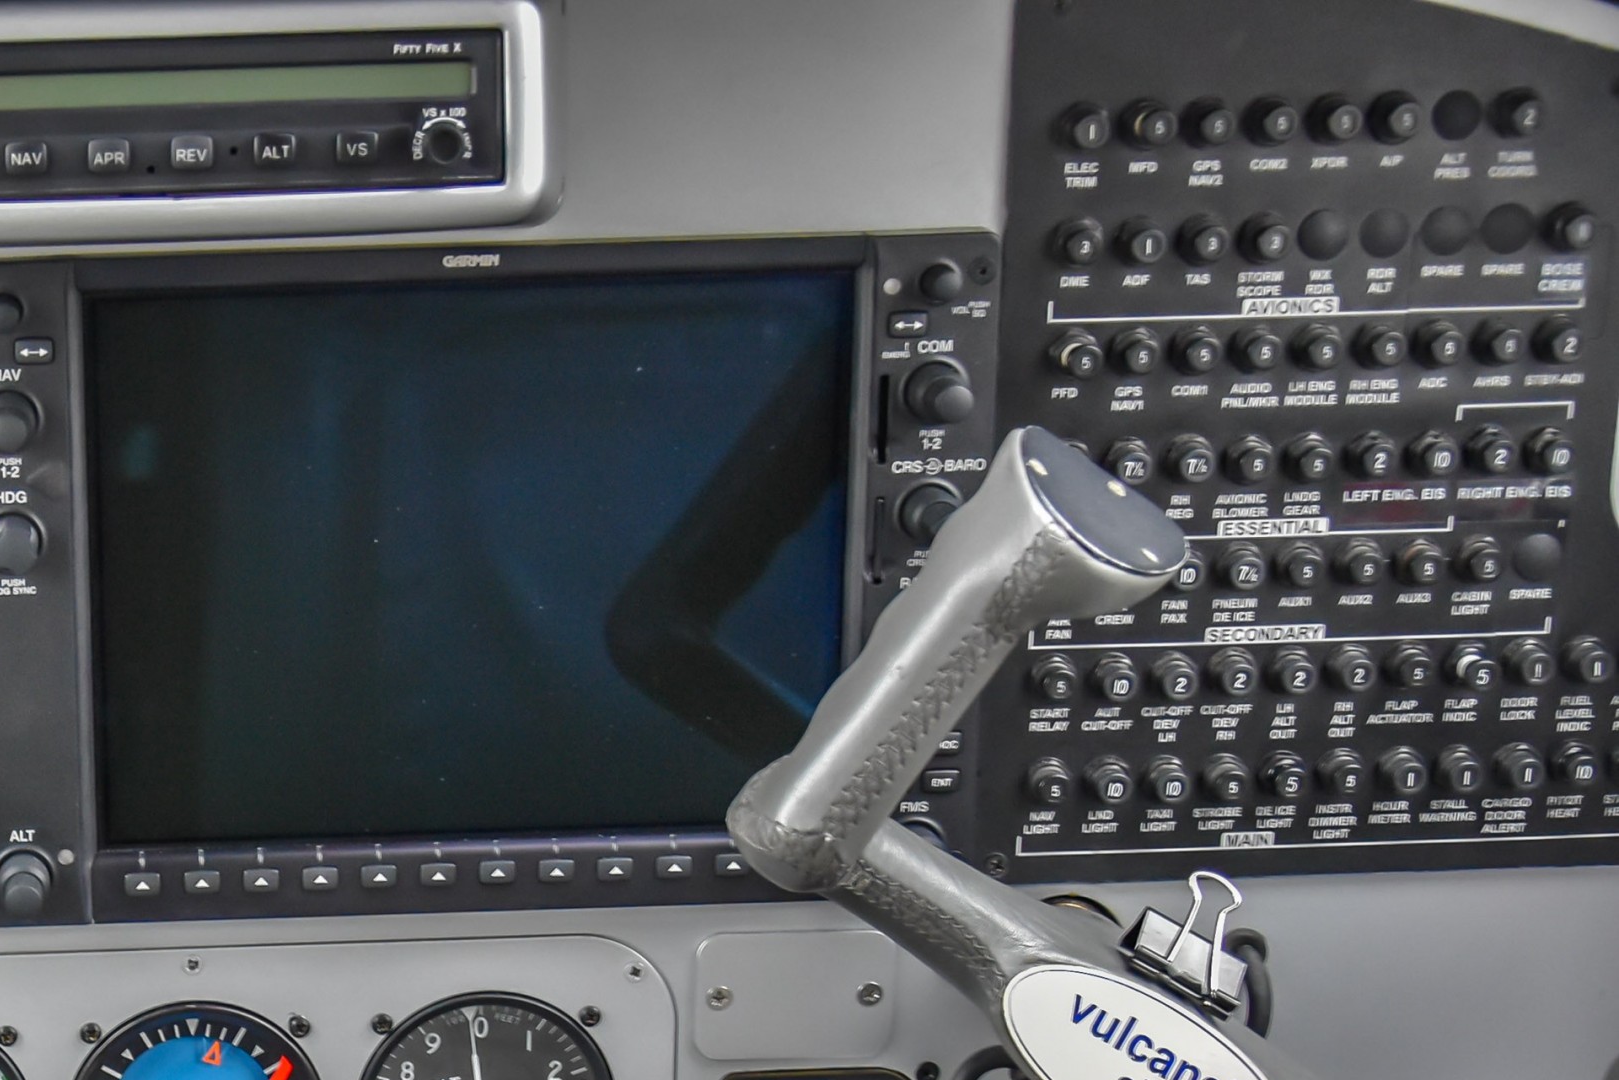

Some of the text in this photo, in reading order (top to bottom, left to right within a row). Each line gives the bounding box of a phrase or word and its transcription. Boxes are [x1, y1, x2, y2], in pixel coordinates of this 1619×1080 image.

[453, 43, 461, 53] X
[175, 146, 208, 163] REV
[261, 143, 291, 160] ALT
[346, 141, 368, 158] VS
[10, 151, 43, 167] NAV
[93, 151, 126, 167] APR
[443, 254, 500, 267] GARMIN
[1245, 299, 1334, 314] AVIONICS
[918, 340, 954, 352] COM
[922, 438, 942, 449] 1-2
[892, 458, 986, 473] CRS BARO
[0, 467, 20, 478] 1-2
[1343, 490, 1381, 503] LEFT
[1421, 488, 1446, 501] EIS
[1457, 487, 1503, 500] RIGHT
[1545, 486, 1571, 498] EIS
[1223, 520, 1323, 535] ESSENTIAL
[1, 579, 26, 587] PUSH
[1207, 625, 1322, 642] SECONDARY
[1030, 708, 1070, 719] START
[1500, 710, 1536, 720] LOCK
[1029, 721, 1070, 732] RELAY
[900, 801, 929, 812] FMS
[1482, 797, 1532, 808] CARGO
[1192, 807, 1243, 817] STROBE
[1419, 811, 1476, 822] WARNING
[10, 830, 35, 842] ALT
[1224, 833, 1272, 846] MAIN
